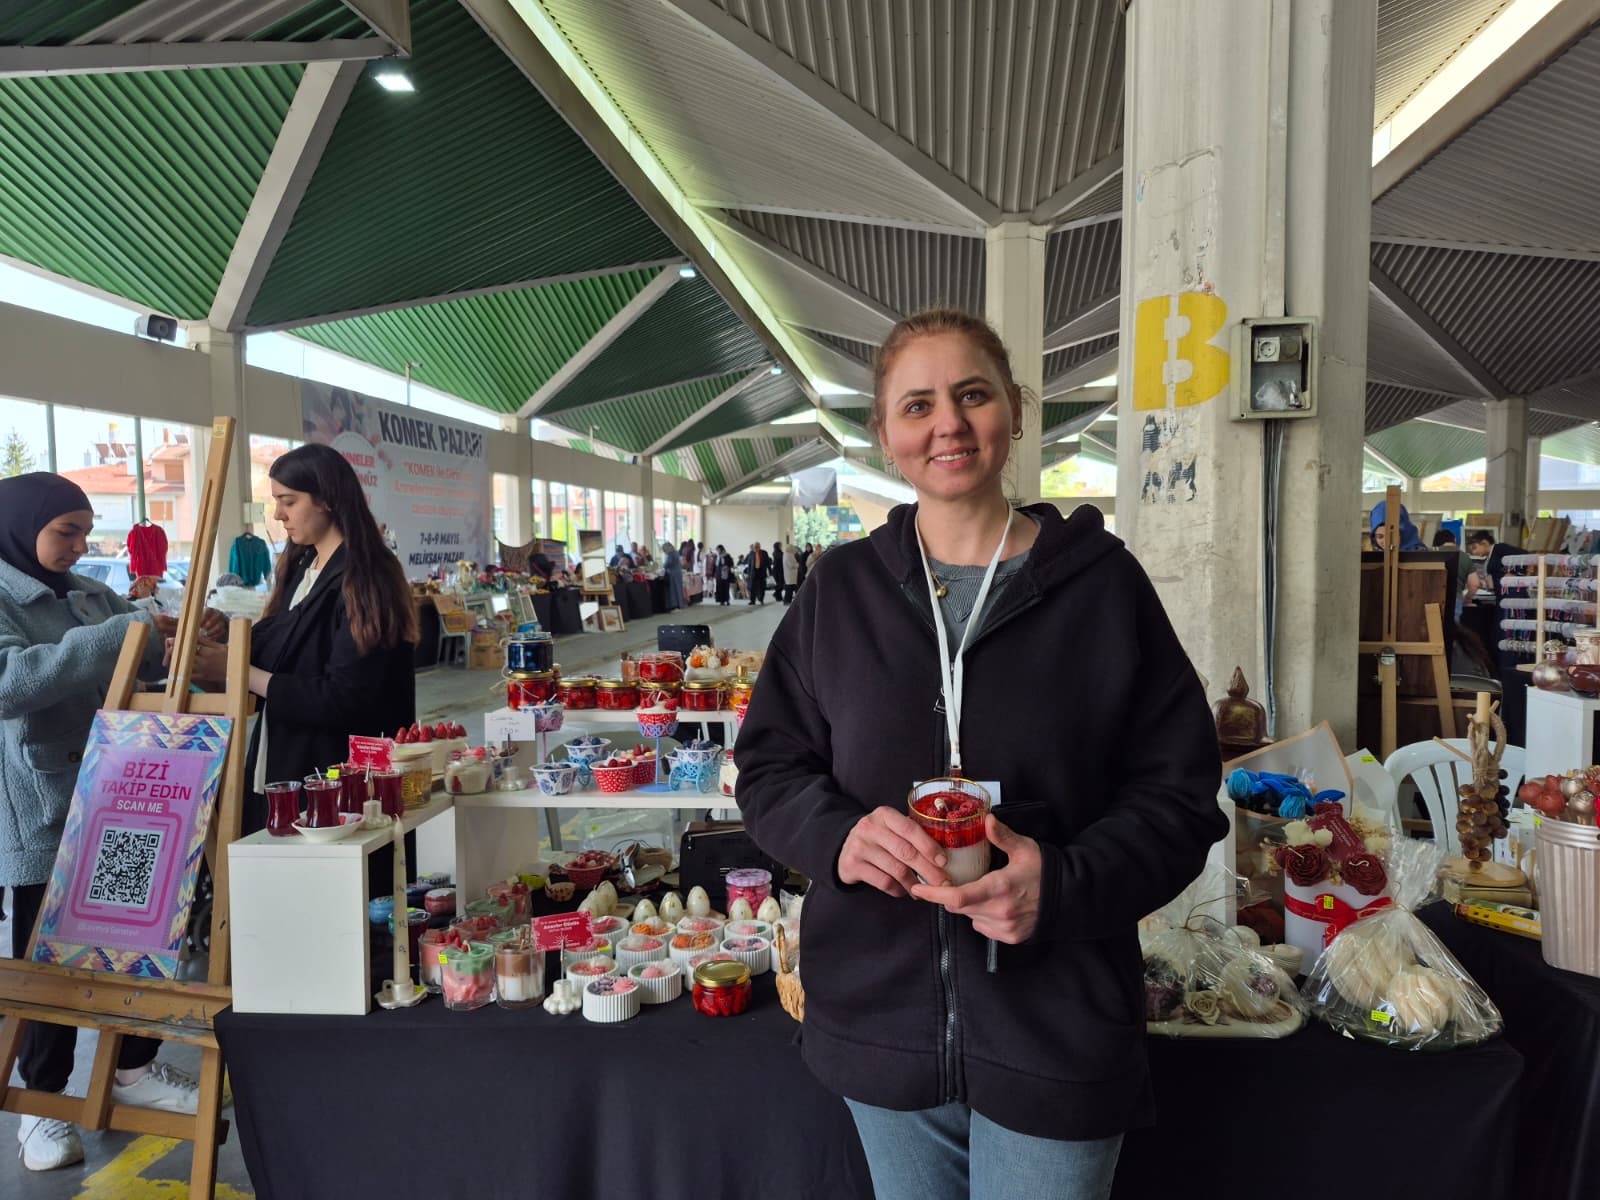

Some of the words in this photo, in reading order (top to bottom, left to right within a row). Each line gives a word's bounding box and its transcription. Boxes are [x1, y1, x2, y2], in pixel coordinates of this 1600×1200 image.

[1133, 291, 1230, 410] B
[378, 411, 437, 451] KOMEK
[122, 758, 170, 781] BİZİ
[101, 779, 147, 796] TAKİP
[149, 782, 192, 800] EDİN
[116, 799, 145, 812] SCAN
[147, 802, 163, 813] ME
